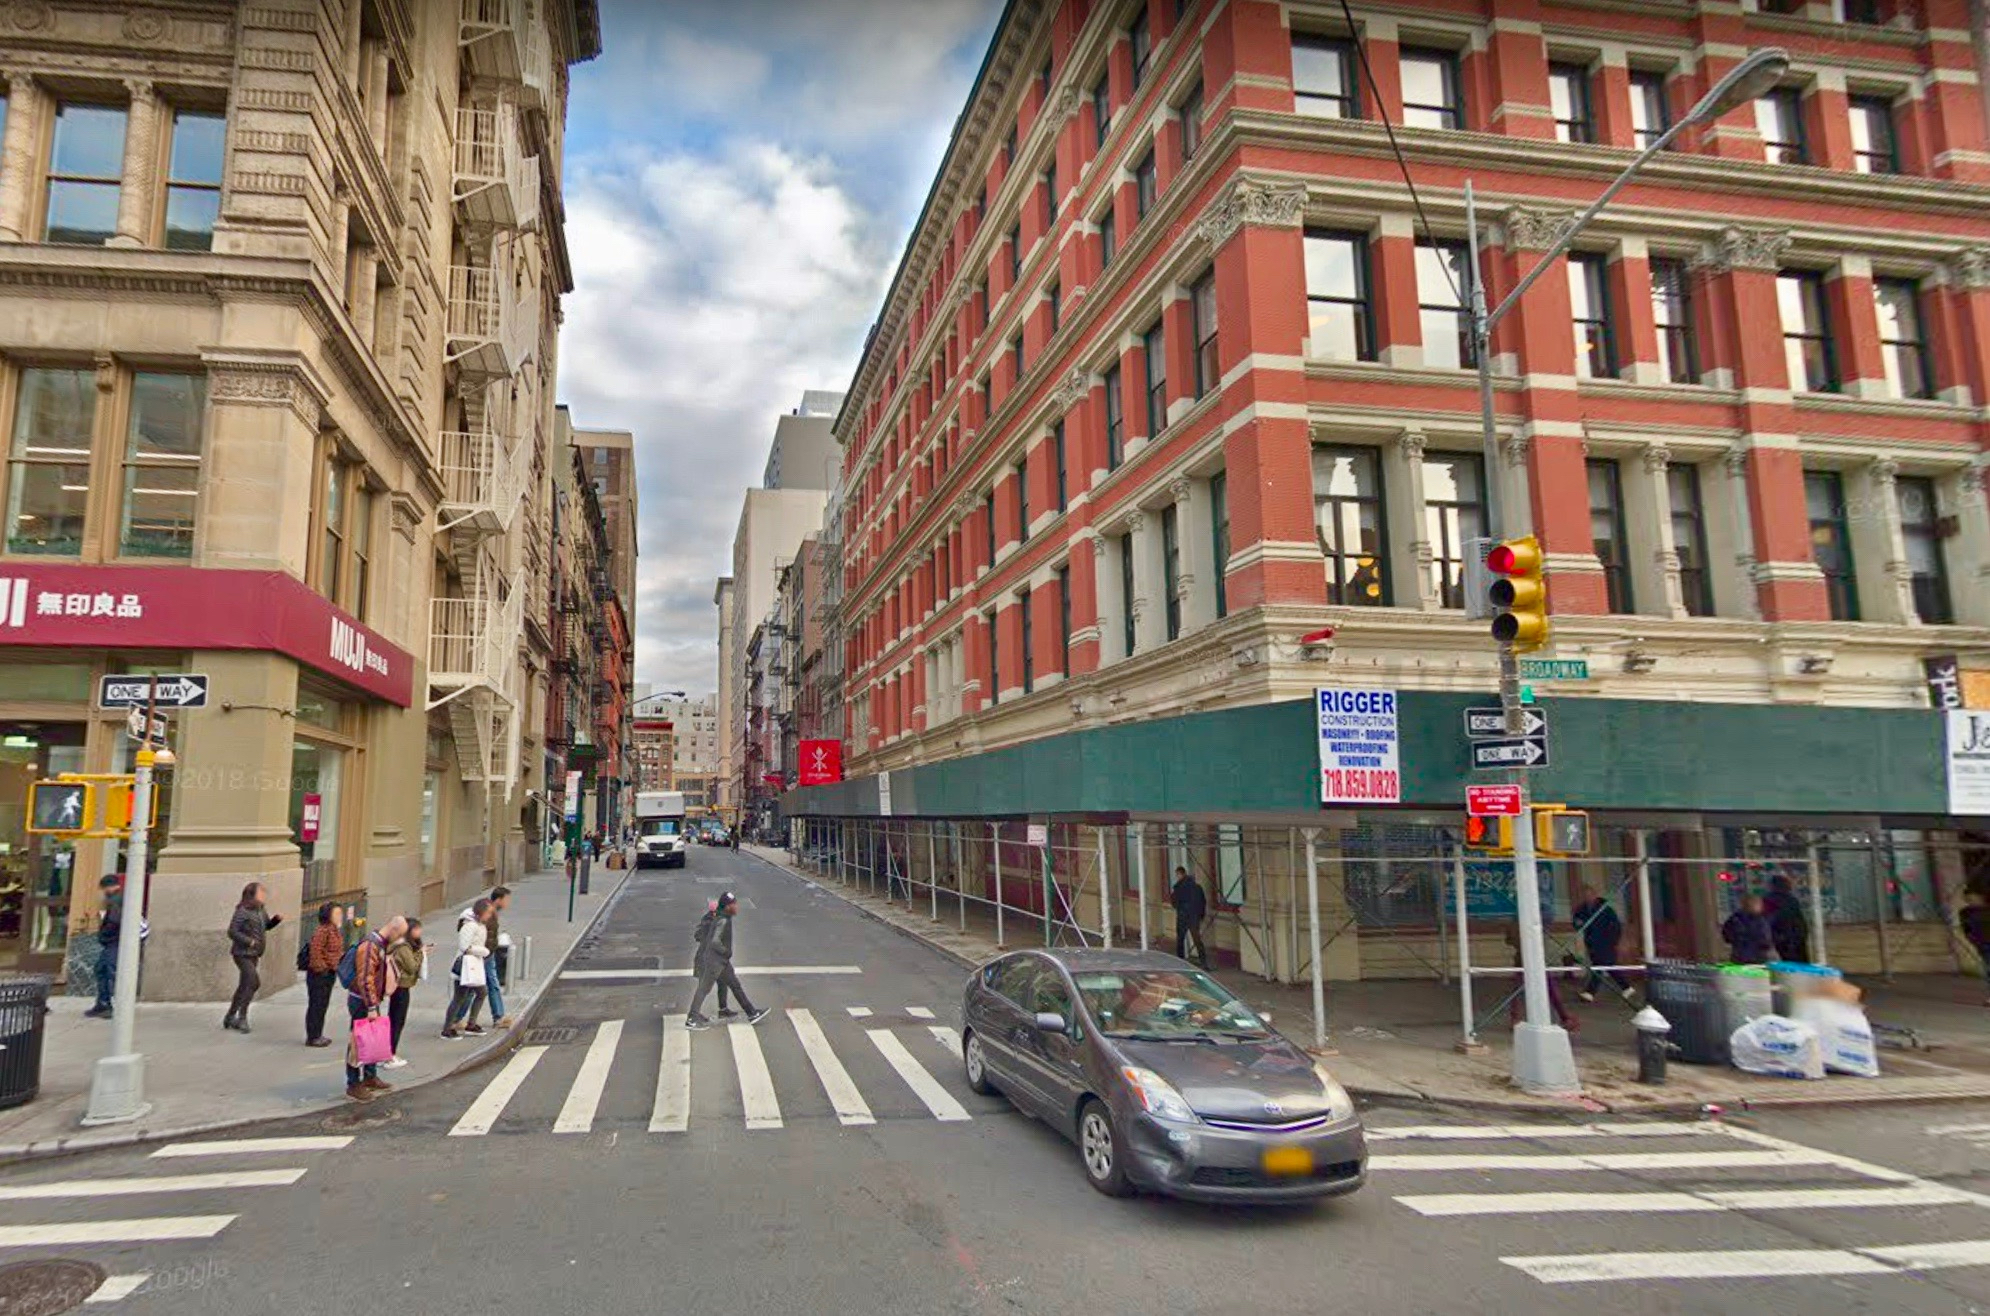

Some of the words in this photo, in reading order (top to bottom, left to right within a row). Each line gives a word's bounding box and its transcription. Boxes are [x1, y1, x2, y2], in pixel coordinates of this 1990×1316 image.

[37, 591, 142, 618] 無印良品
[330, 615, 365, 673] MUJI
[110, 684, 141, 698] ONE
[160, 684, 193, 697] WAY
[1321, 690, 1395, 714] RIGGER
[1321, 714, 1395, 727] CONSTRUCTION
[1474, 716, 1497, 729] ONE
[1329, 741, 1388, 754] WATERPROOFING
[1481, 747, 1502, 761] ONE
[1509, 746, 1536, 759] WAY
[1338, 754, 1381, 767] RENOVATION
